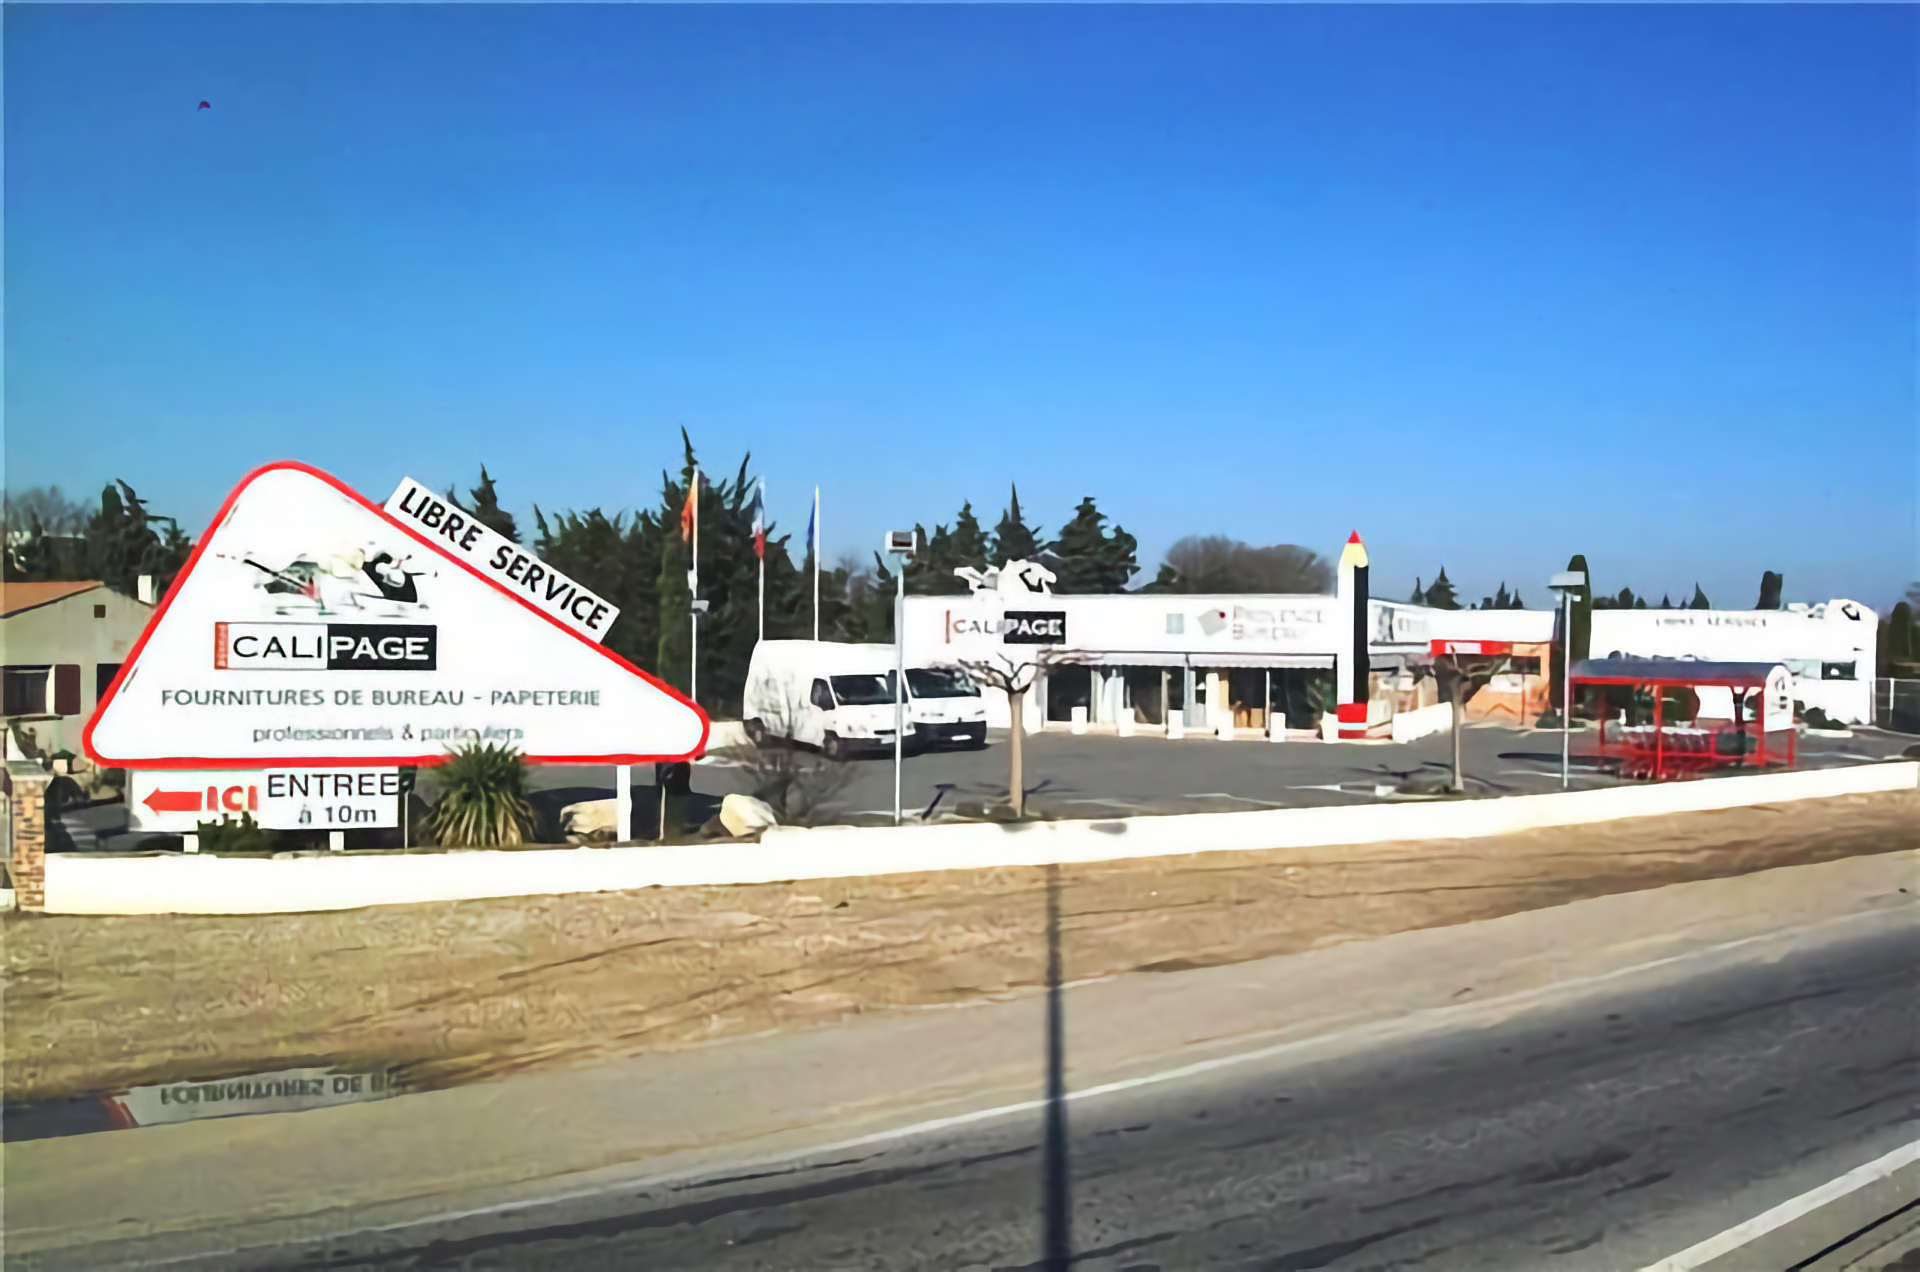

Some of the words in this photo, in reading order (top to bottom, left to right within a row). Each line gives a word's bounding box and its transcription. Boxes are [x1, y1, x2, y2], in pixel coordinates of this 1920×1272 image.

[399, 487, 483, 552] LIBRE
[489, 545, 609, 630] SERVICE
[161, 689, 325, 707] FOURNITURES
[334, 689, 363, 706] DE
[372, 689, 464, 706] BUREAU
[491, 689, 600, 707] PAPETERIE
[401, 723, 414, 741] &
[267, 773, 399, 798] ENTREE
[206, 785, 259, 812] ICI
[325, 804, 377, 824] 10m
